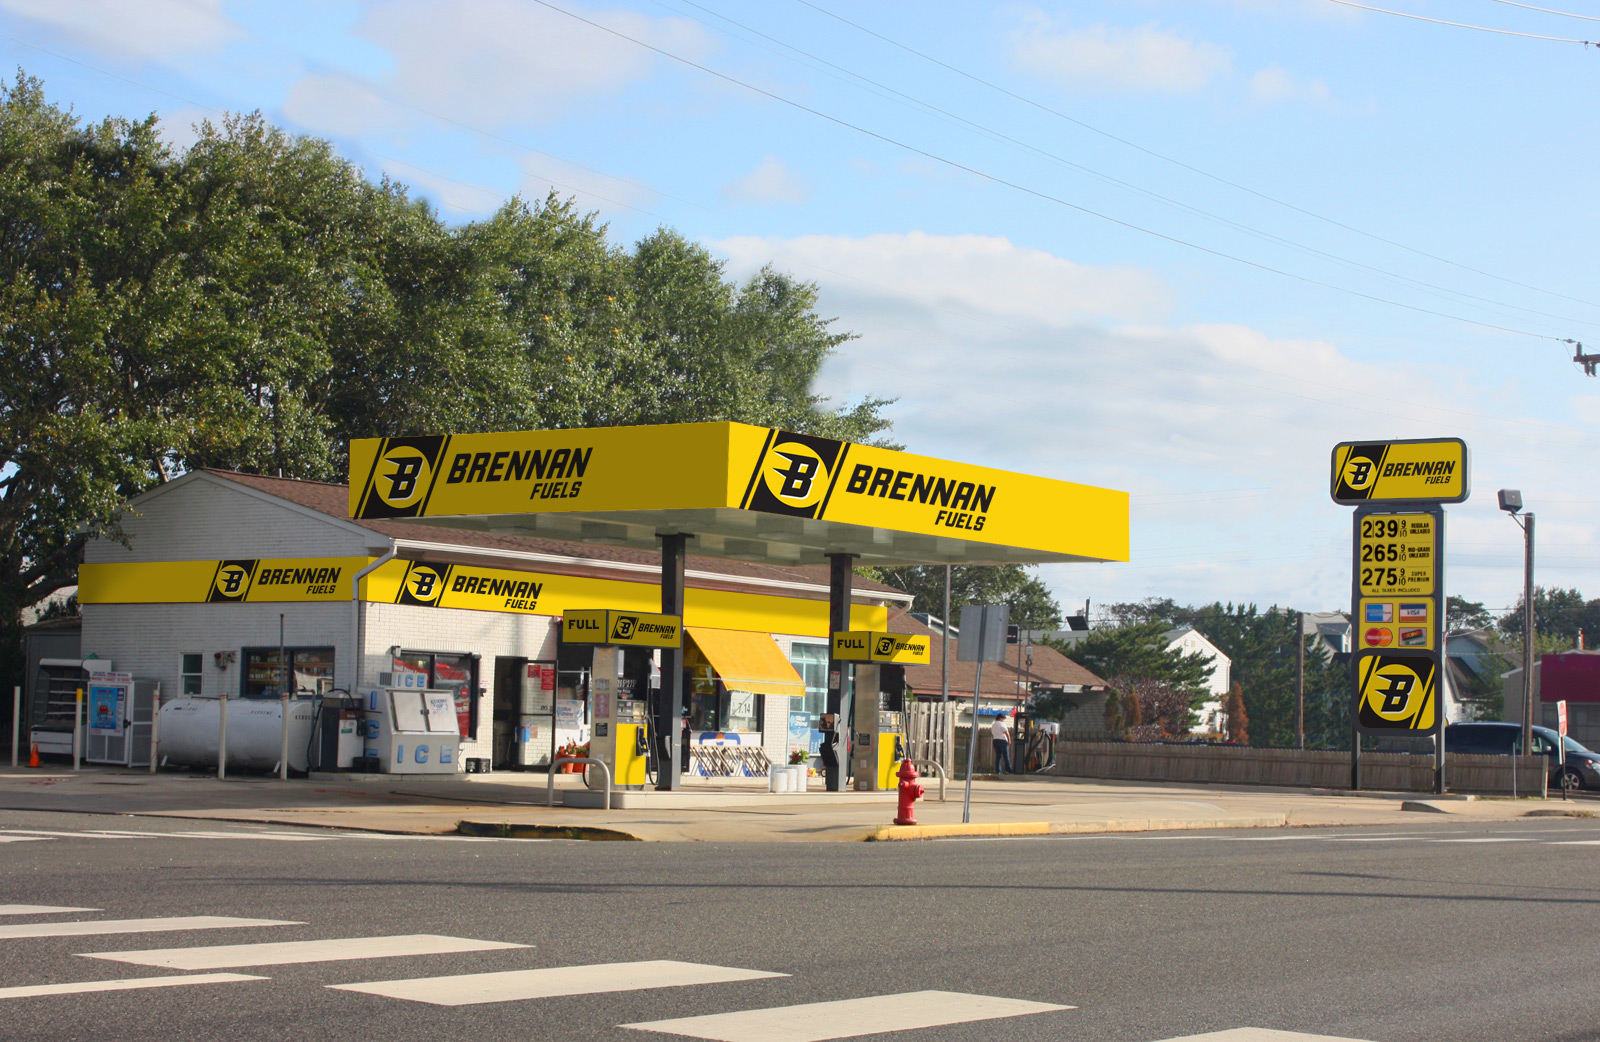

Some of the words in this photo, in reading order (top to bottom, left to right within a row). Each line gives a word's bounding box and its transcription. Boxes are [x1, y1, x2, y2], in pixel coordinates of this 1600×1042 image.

[446, 447, 593, 484] BRENNAN
[1382, 461, 1456, 478] BRENNAN
[846, 463, 996, 513] BRENNAN
[1424, 476, 1451, 485] FUELS
[530, 481, 583, 500] FUELS
[935, 510, 986, 531] FUELS
[1362, 519, 1398, 538] 239
[1362, 543, 1398, 562] 265
[258, 567, 342, 585] BRENNAN
[1361, 568, 1398, 586] 275
[306, 585, 336, 594] FUELS
[451, 575, 543, 599] BRENNAN
[504, 598, 537, 611] FUELS
[568, 619, 600, 630] FULL
[638, 623, 676, 635] BRENNAN
[837, 639, 864, 649] FULL
[895, 643, 925, 652] BRENNAN
[397, 674, 425, 688] ICE
[397, 744, 453, 764] ICE
